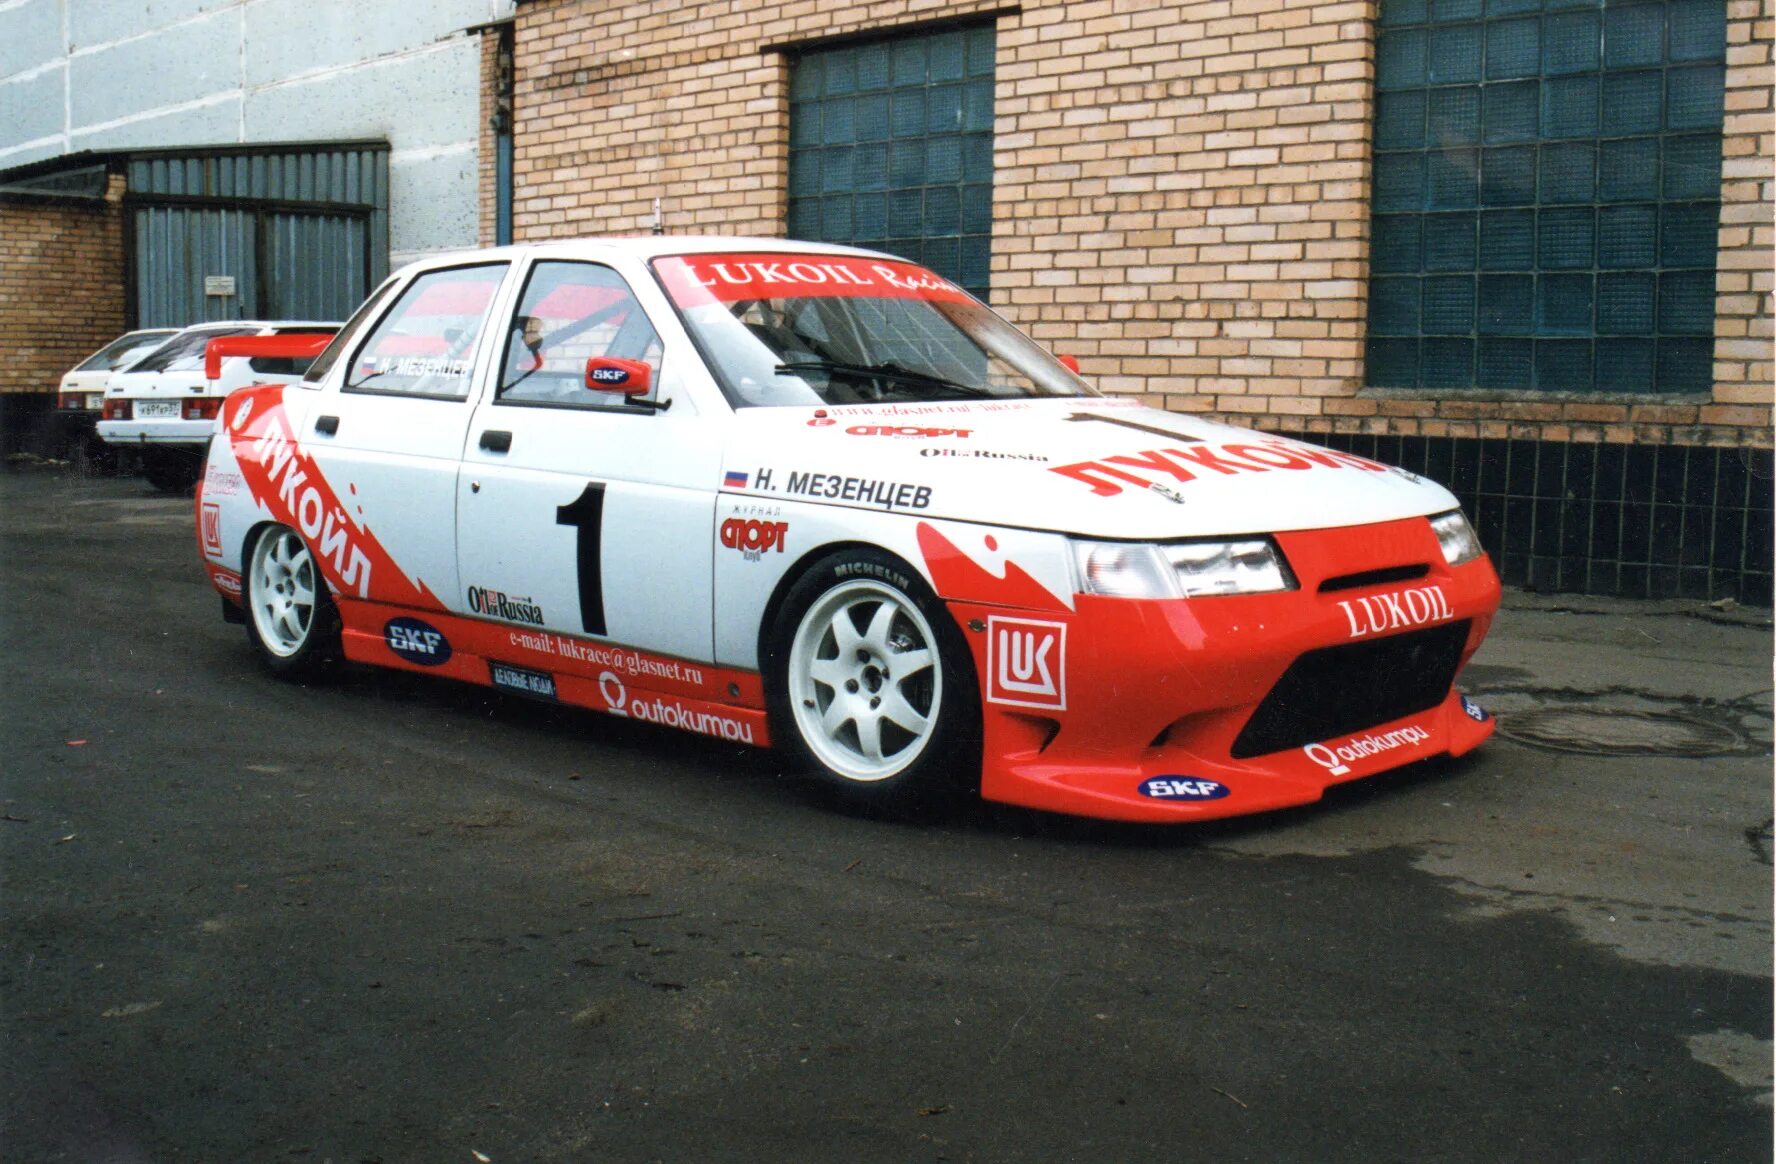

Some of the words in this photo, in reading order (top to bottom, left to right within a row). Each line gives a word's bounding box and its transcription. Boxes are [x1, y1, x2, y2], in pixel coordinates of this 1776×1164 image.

[681, 262, 875, 288] LUKOIL
[871, 265, 962, 293] Racin
[591, 369, 625, 381] SKF
[845, 425, 973, 438] СПОРТ
[252, 415, 372, 599] ЛУКОЙЛ
[754, 467, 777, 491] Н.
[786, 471, 933, 510] МЕЗЕНЦЕВ
[720, 518, 789, 553] СПОРТ
[556, 482, 608, 636] 1
[834, 561, 910, 590] MICHELIN
[468, 585, 490, 615] Oil
[496, 592, 545, 626] Russia
[1336, 585, 1455, 638] LUKOIL
[389, 625, 442, 655] SKF
[509, 630, 554, 655] e-mail:
[557, 636, 704, 687] lukrace@glasnet.ru
[631, 698, 754, 745] outokumpu
[1336, 725, 1431, 762] outokumpu
[1147, 781, 1220, 798] SKF
